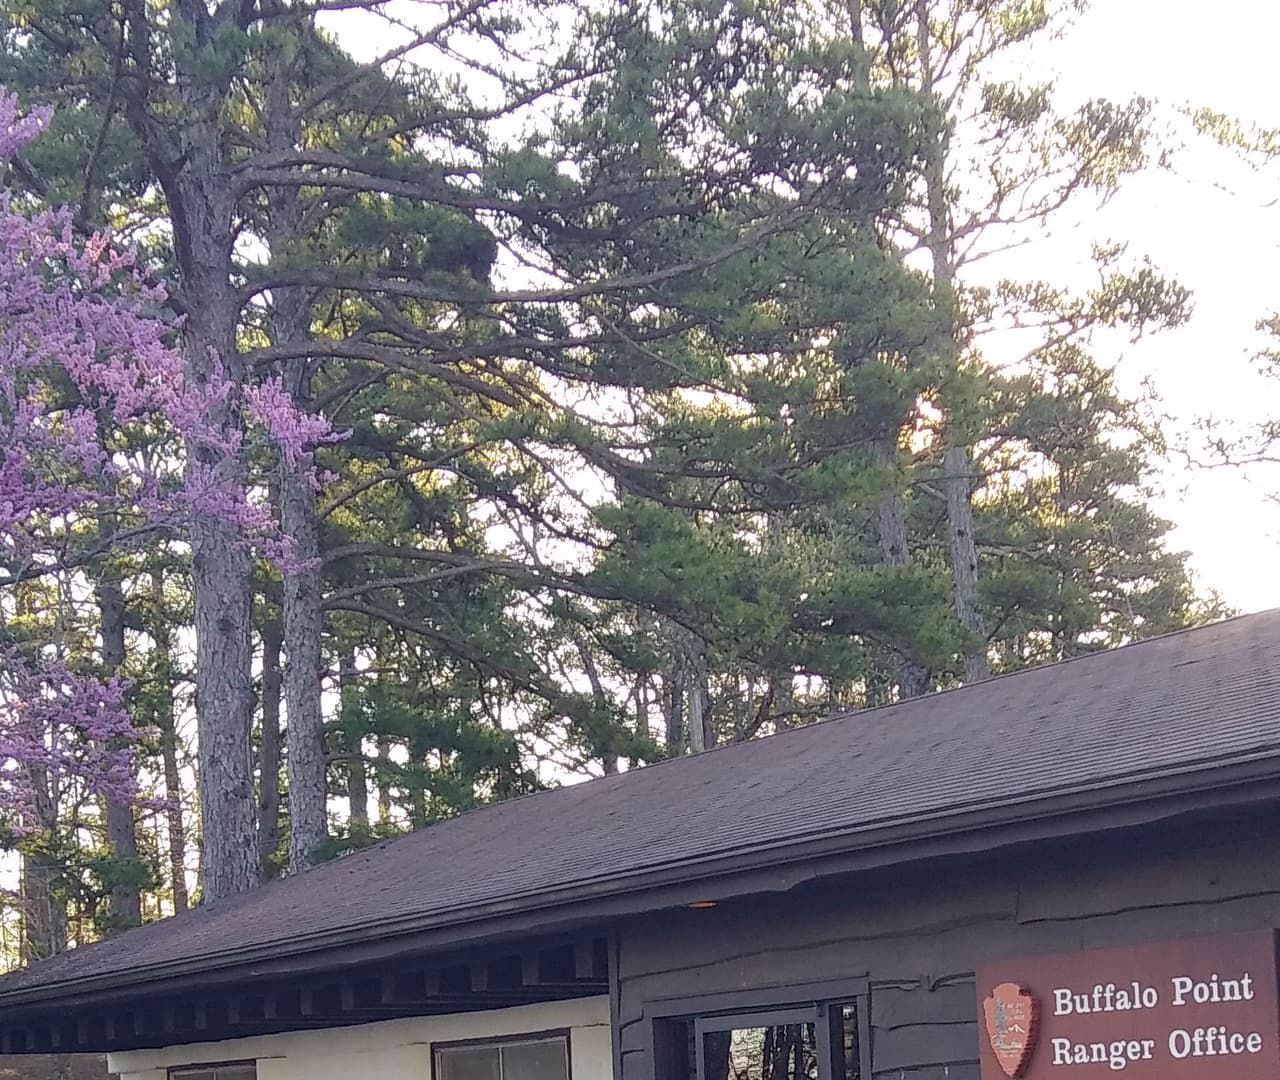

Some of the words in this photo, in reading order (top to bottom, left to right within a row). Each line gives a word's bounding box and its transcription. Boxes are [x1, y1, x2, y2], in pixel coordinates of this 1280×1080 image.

[1053, 982, 1158, 1016] Buffalo
[1172, 972, 1254, 1006] Point
[1051, 1037, 1155, 1070] Ranger
[1168, 1026, 1262, 1058] Office
